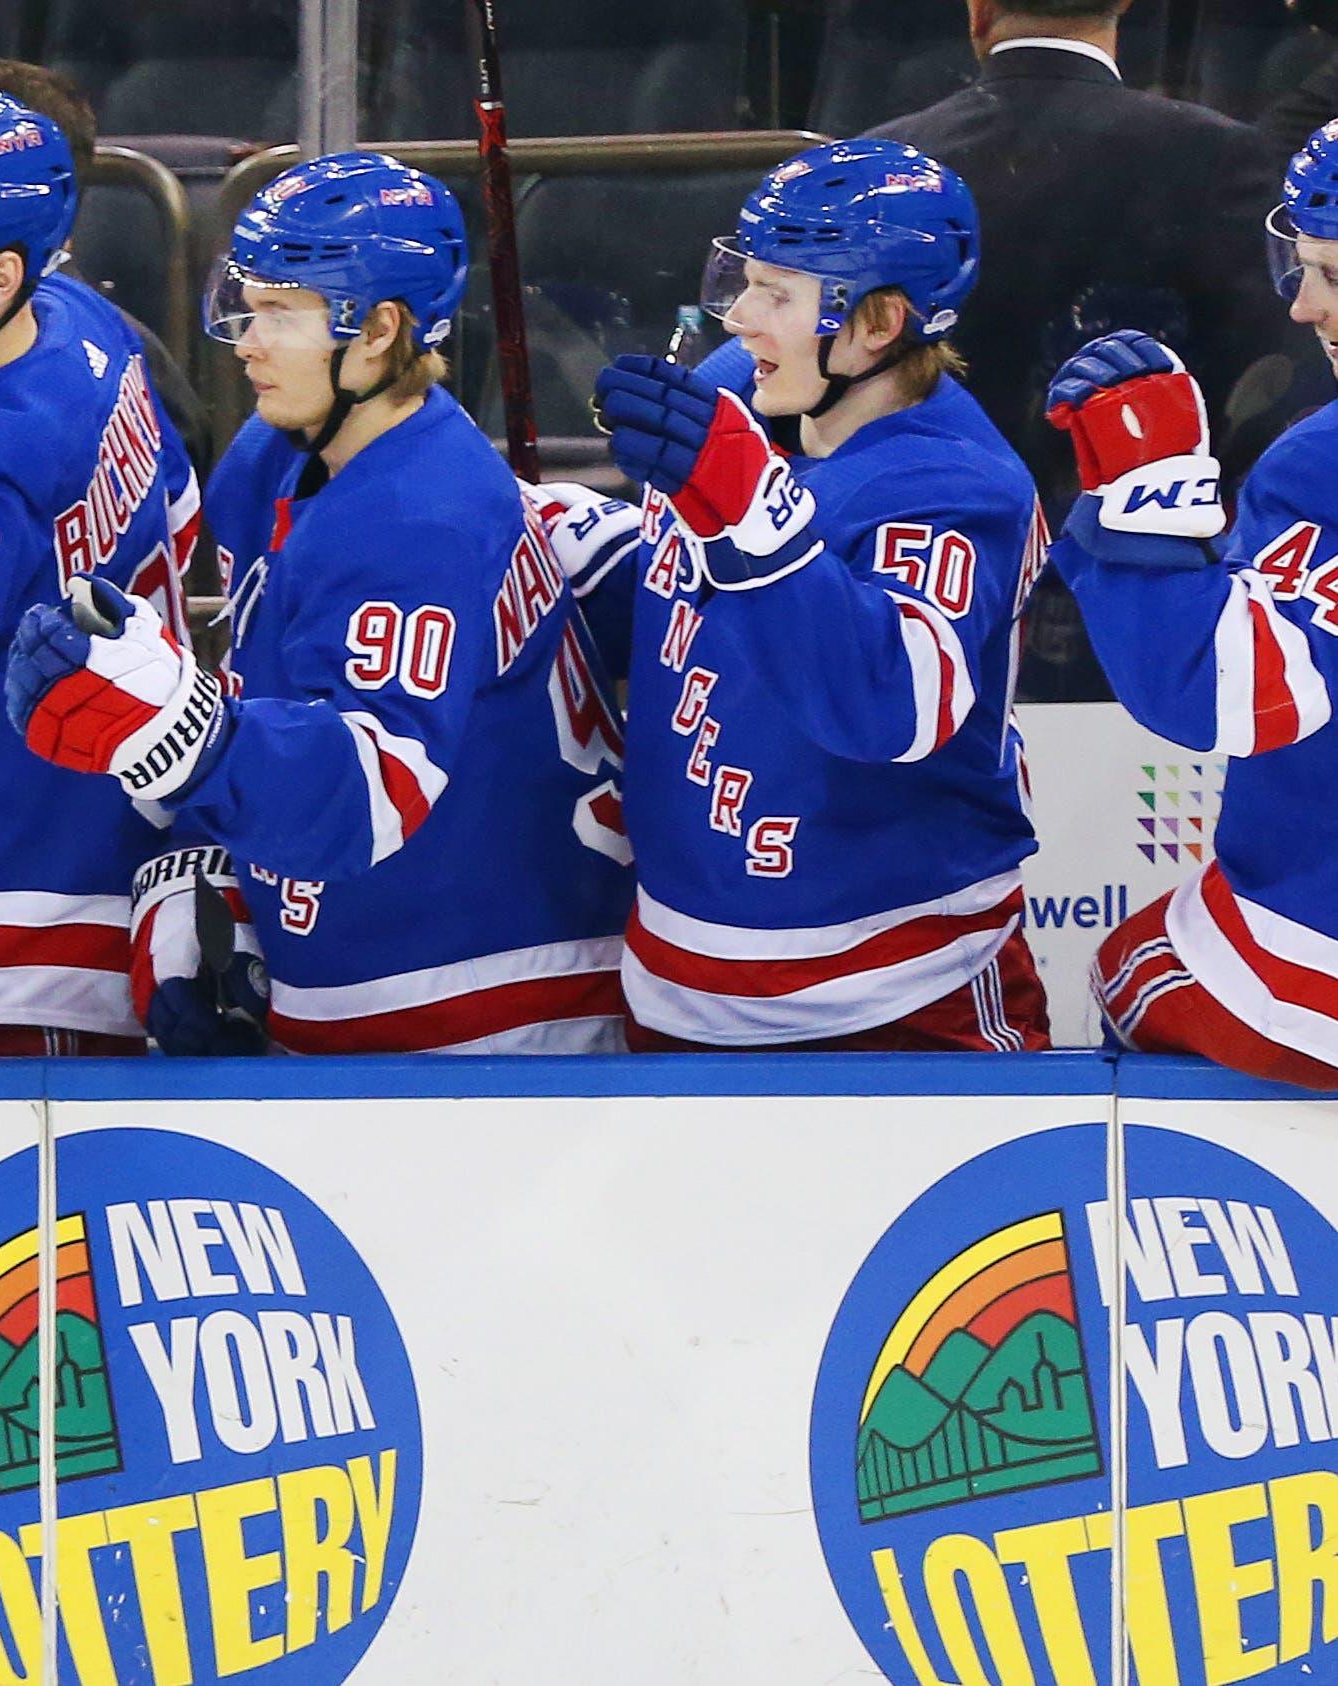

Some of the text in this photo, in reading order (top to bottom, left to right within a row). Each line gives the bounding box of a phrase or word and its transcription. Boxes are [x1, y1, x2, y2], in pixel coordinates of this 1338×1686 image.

[873, 522, 977, 620] 50
[345, 600, 458, 700] 90
[1021, 884, 1127, 929] well
[105, 1198, 307, 1307] NEW
[1085, 1196, 1300, 1307] NEW
[128, 1309, 377, 1465] YORK
